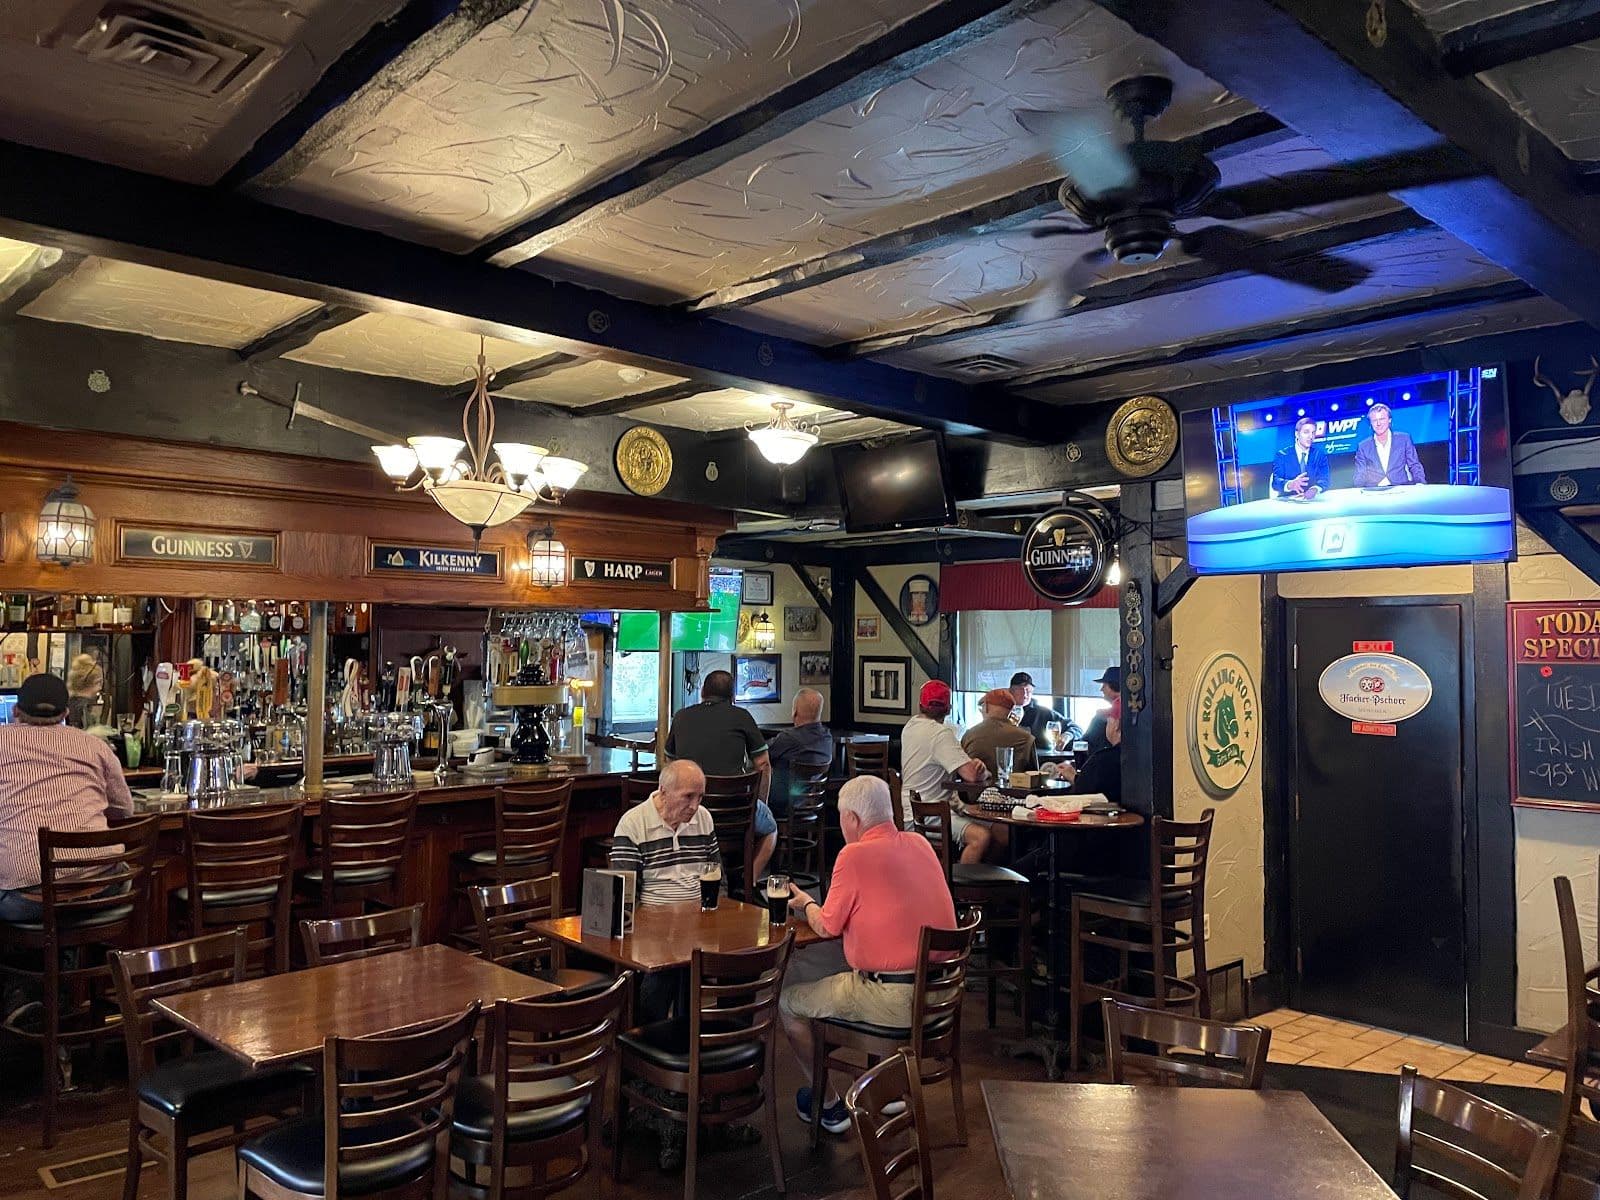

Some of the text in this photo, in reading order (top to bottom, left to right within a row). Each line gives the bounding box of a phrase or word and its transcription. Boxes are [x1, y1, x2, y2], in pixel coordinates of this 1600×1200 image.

[1328, 417, 1362, 434] WPT
[151, 535, 234, 558] GUINNESS
[419, 550, 482, 568] KILKENNY
[1031, 548, 1093, 567] GUINN
[604, 562, 643, 580] HARP
[1358, 643, 1387, 652] EXIT
[1202, 668, 1253, 722] ROLLING ROCK
[1340, 693, 1406, 706] Hacker-Pschorr
[1535, 738, 1595, 761] IRISH
